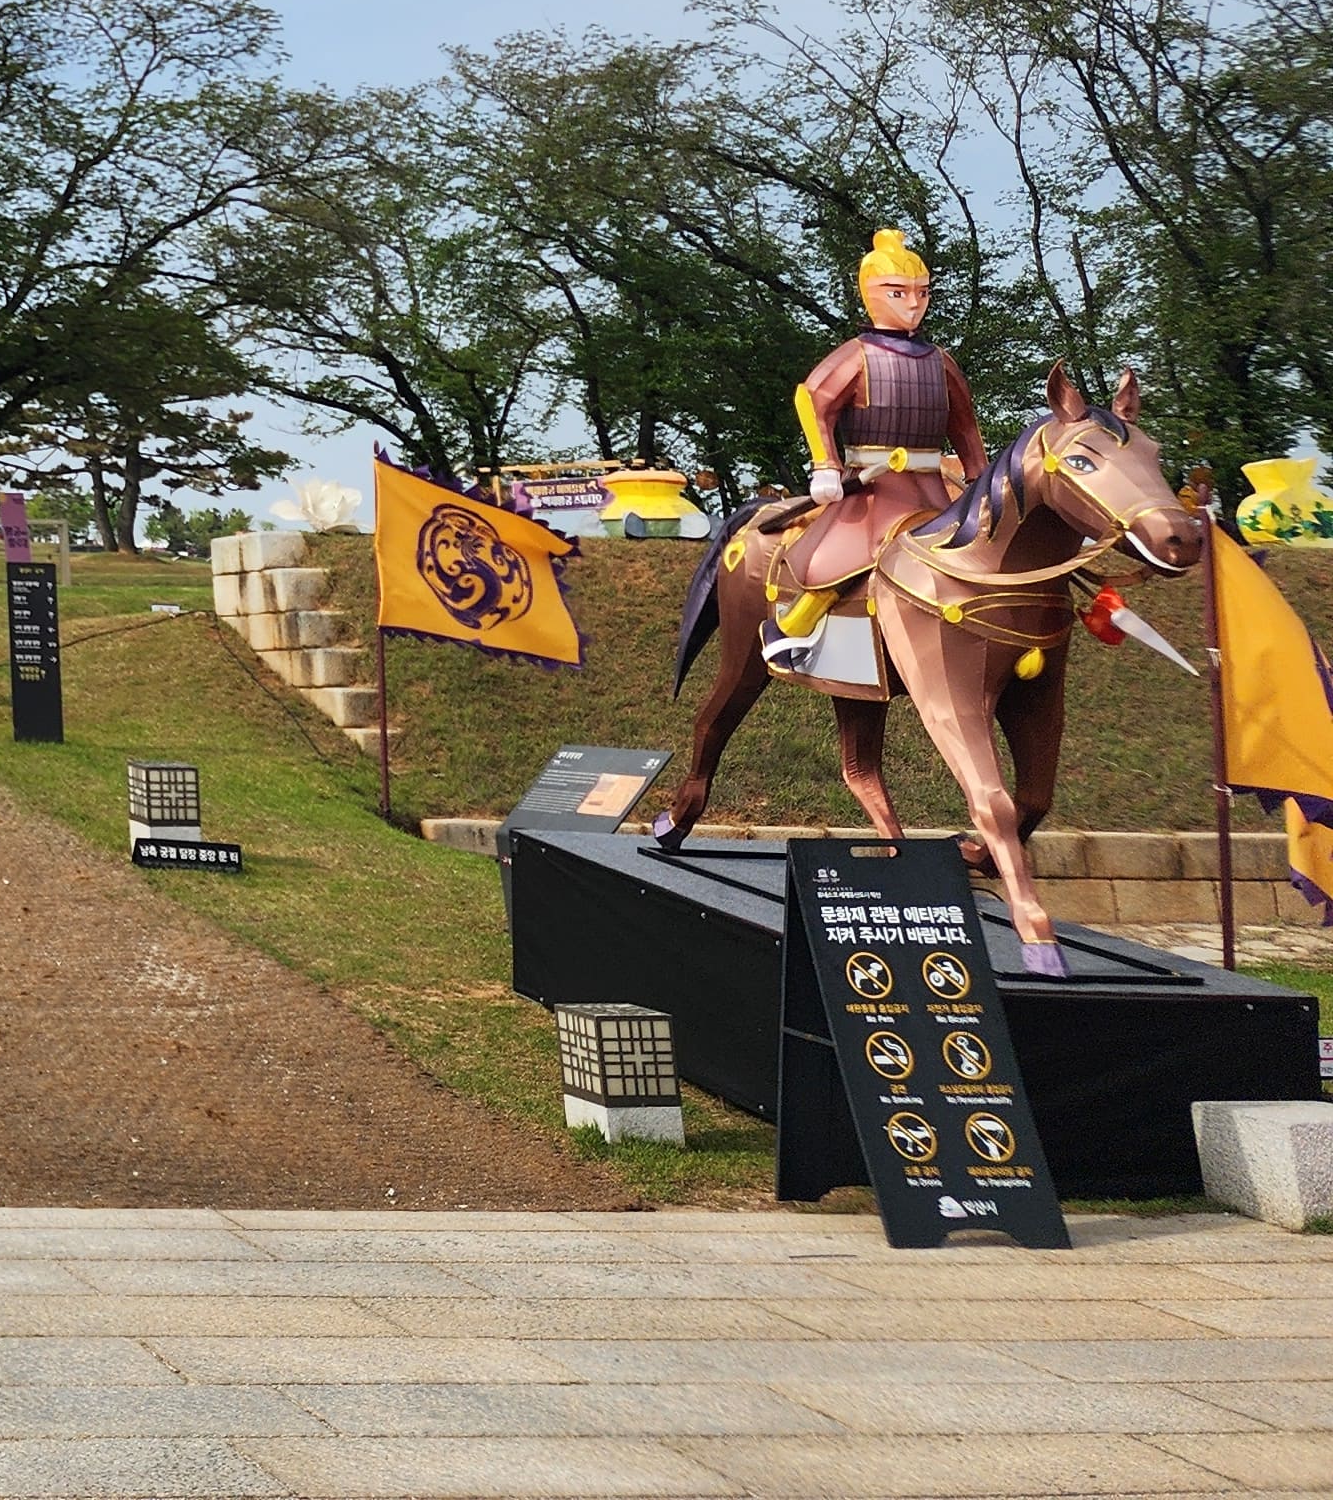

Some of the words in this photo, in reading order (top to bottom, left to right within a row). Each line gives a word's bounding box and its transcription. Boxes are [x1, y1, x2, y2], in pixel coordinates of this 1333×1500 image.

[140, 845, 158, 857] 남측
[199, 849, 216, 862] 중앙
[820, 905, 867, 923] 문화재
[868, 906, 901, 924] 관람
[903, 905, 965, 924] 에티켓을
[825, 926, 857, 944] 지켜
[859, 926, 905, 944] 주시기
[907, 926, 973, 945] 바랍니다.
